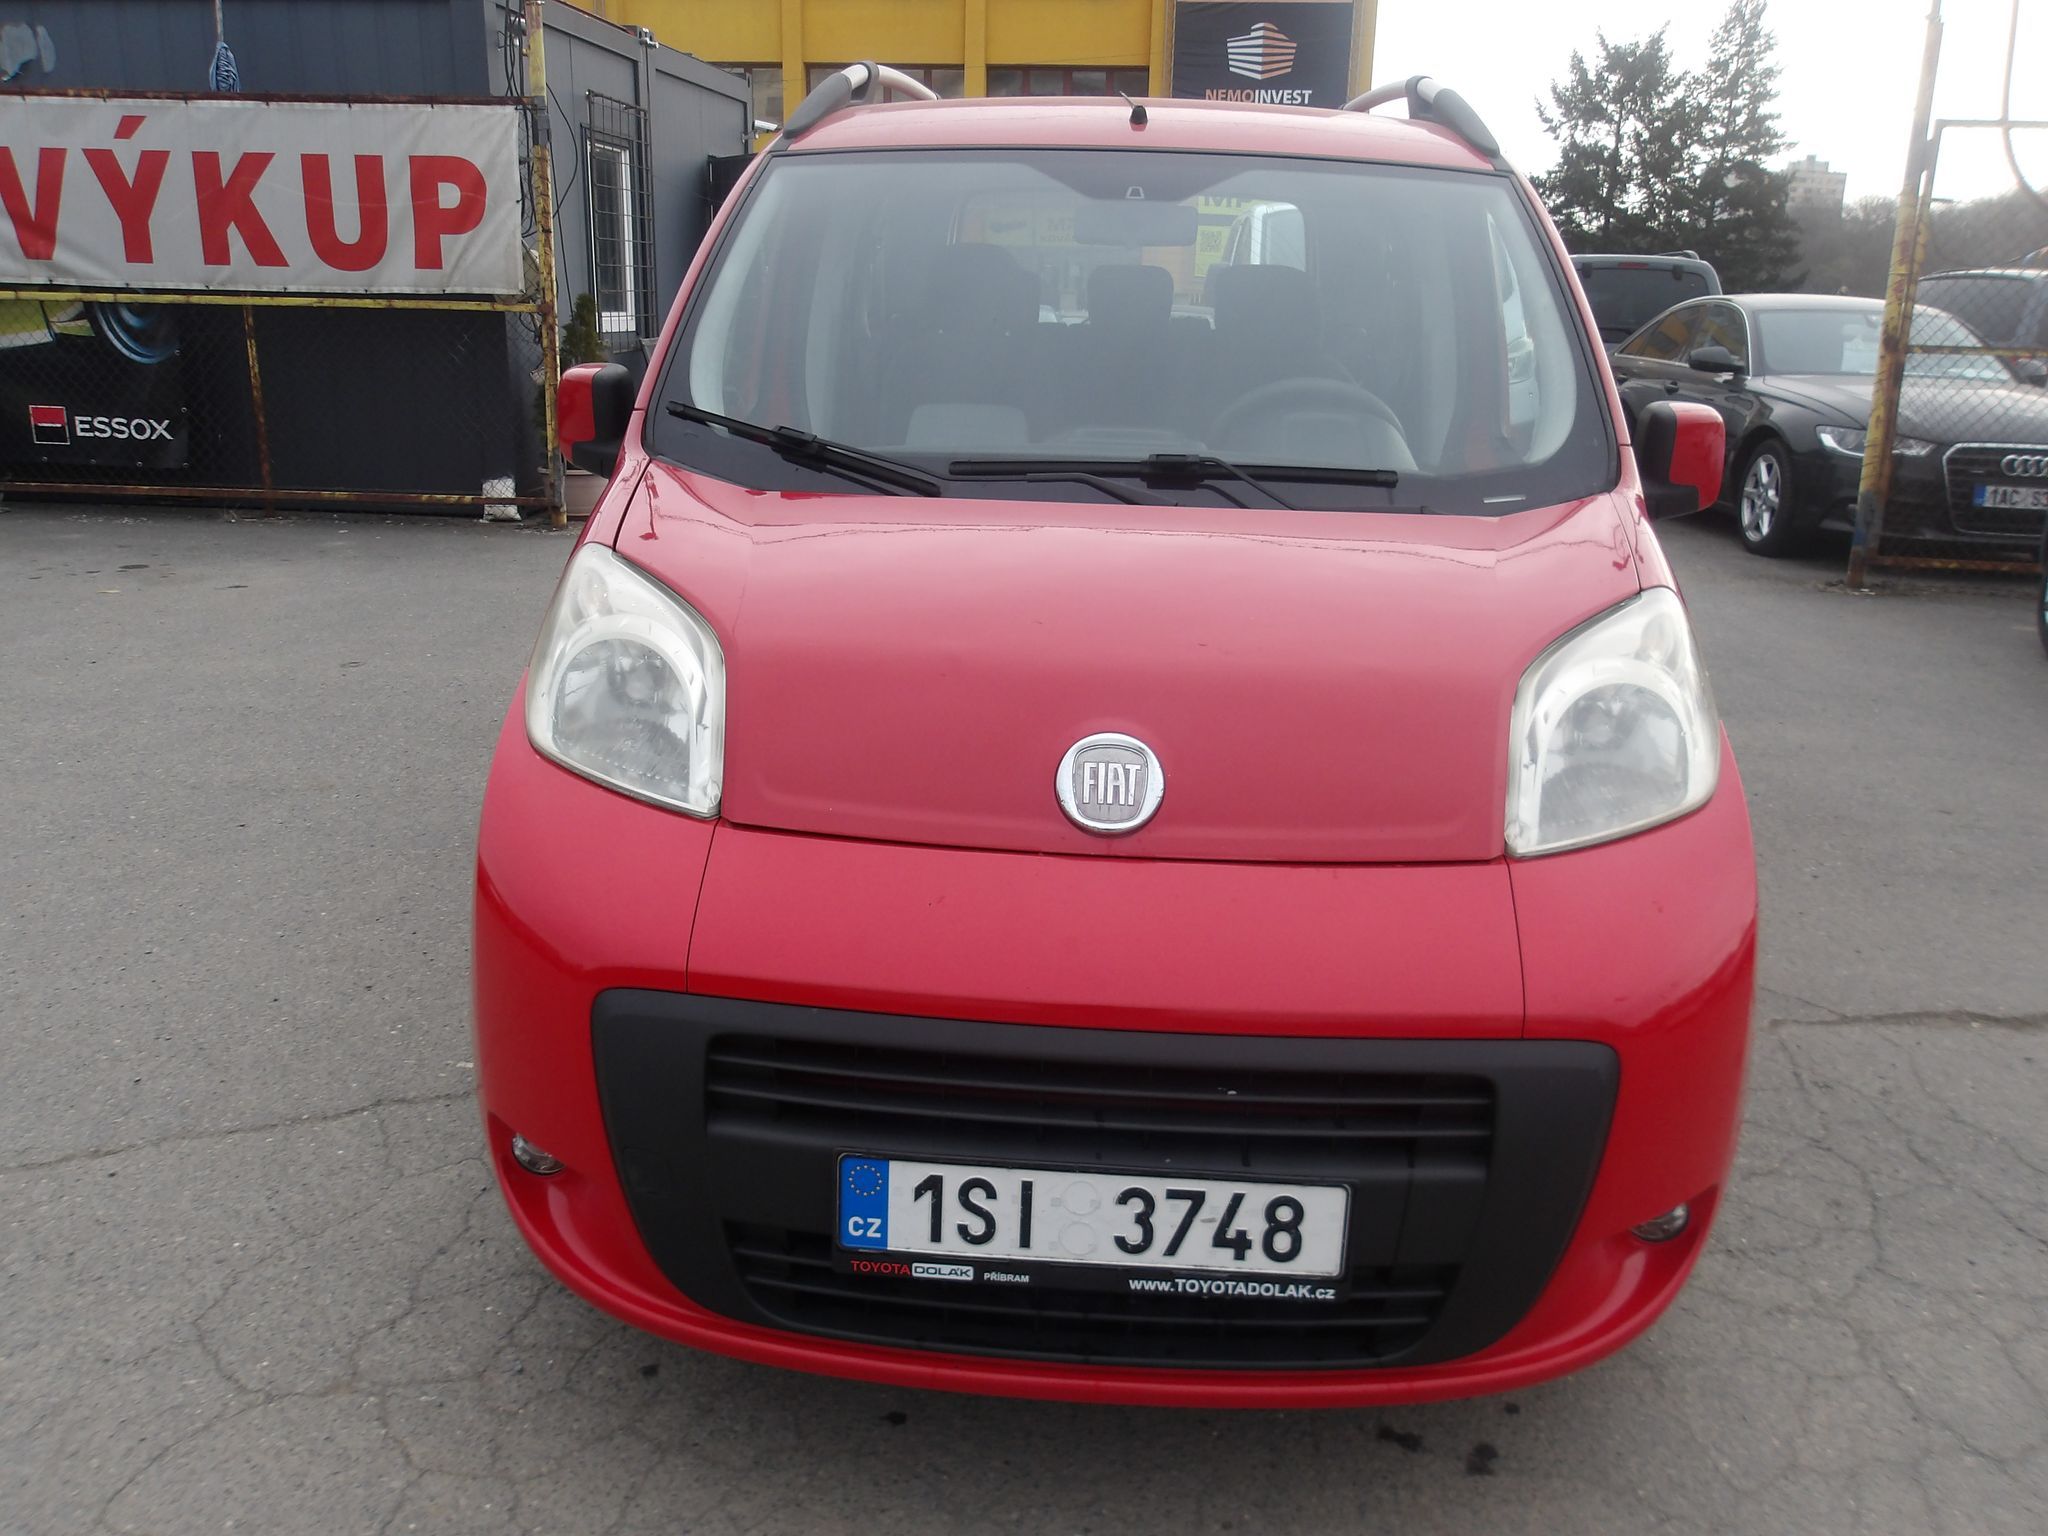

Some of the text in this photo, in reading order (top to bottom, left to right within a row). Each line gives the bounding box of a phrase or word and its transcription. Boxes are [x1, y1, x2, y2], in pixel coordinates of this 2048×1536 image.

[1205, 88, 1312, 104] NEMOINVEST
[0, 115, 488, 272] VÝKUP
[74, 416, 175, 440] ESSOX
[1082, 761, 1142, 807] FIAT
[848, 1216, 882, 1238] CZ
[914, 1173, 1305, 1263] 1SI 3748
[850, 1259, 911, 1276] TOYOTA
[983, 1271, 1030, 1283] PŘÍBRAM
[1128, 1278, 1336, 1300] www.TOYOTADOLAK.cz
